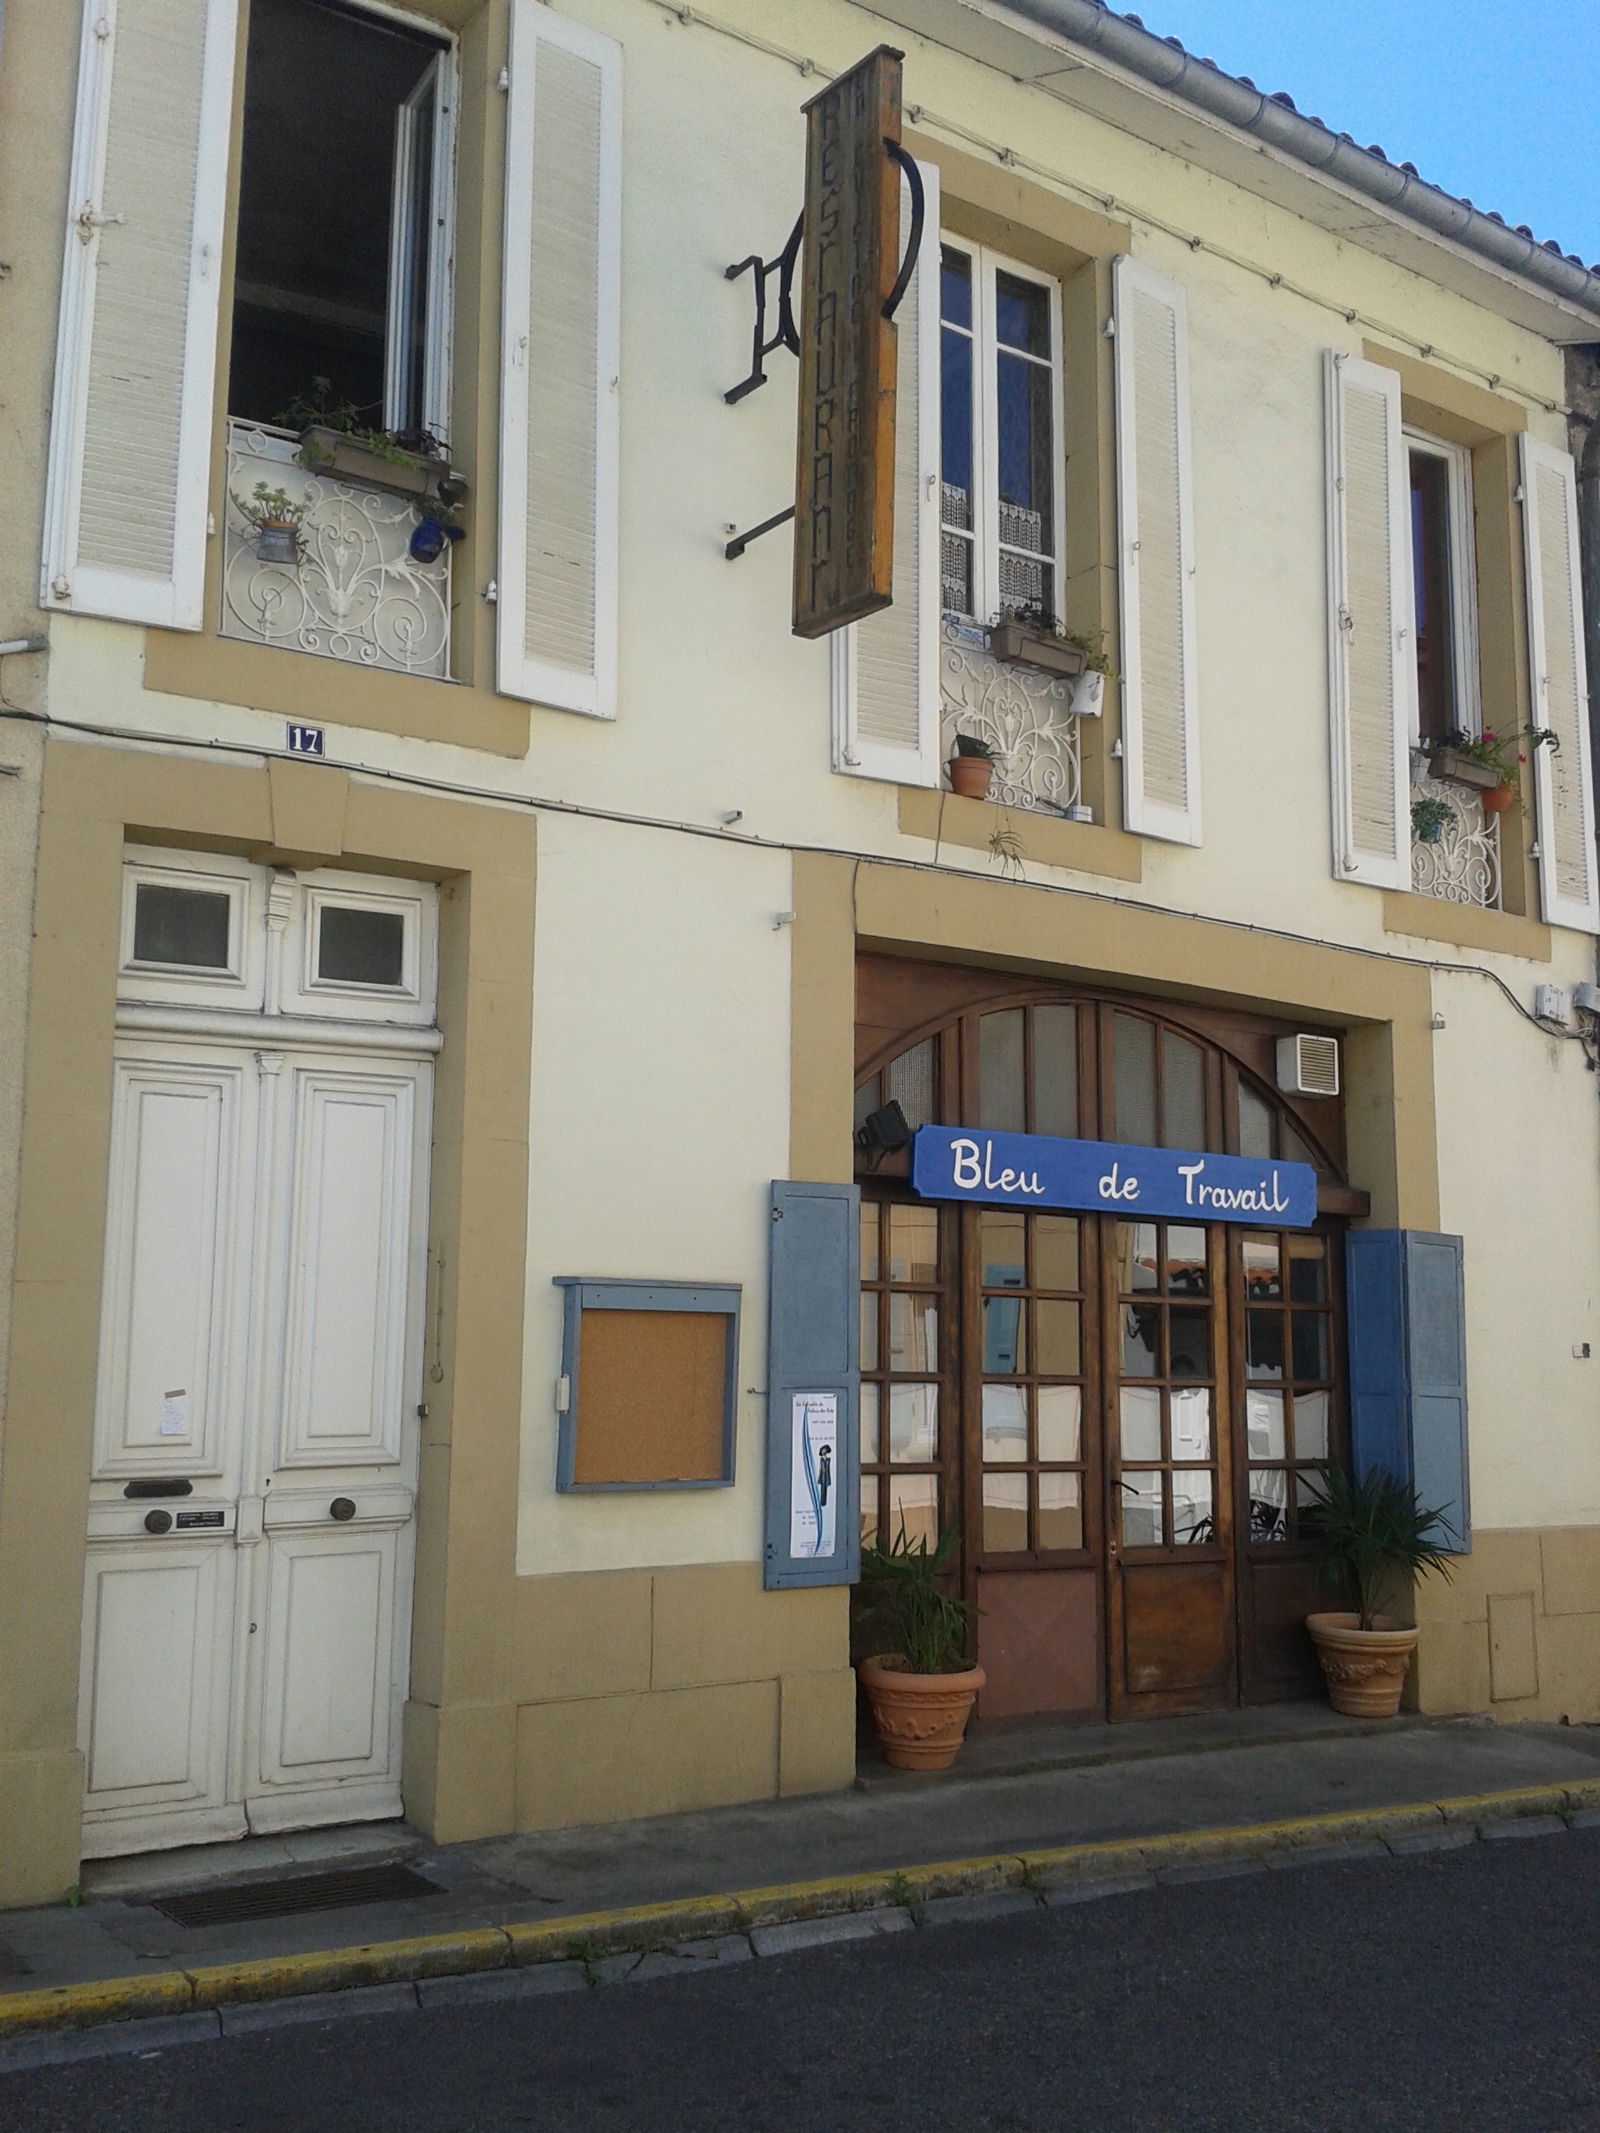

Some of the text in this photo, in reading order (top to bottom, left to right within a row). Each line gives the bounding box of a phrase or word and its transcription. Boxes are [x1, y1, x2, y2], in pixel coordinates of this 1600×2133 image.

[293, 727, 318, 753] 17
[950, 1138, 1289, 1213] Bleu de Travail
